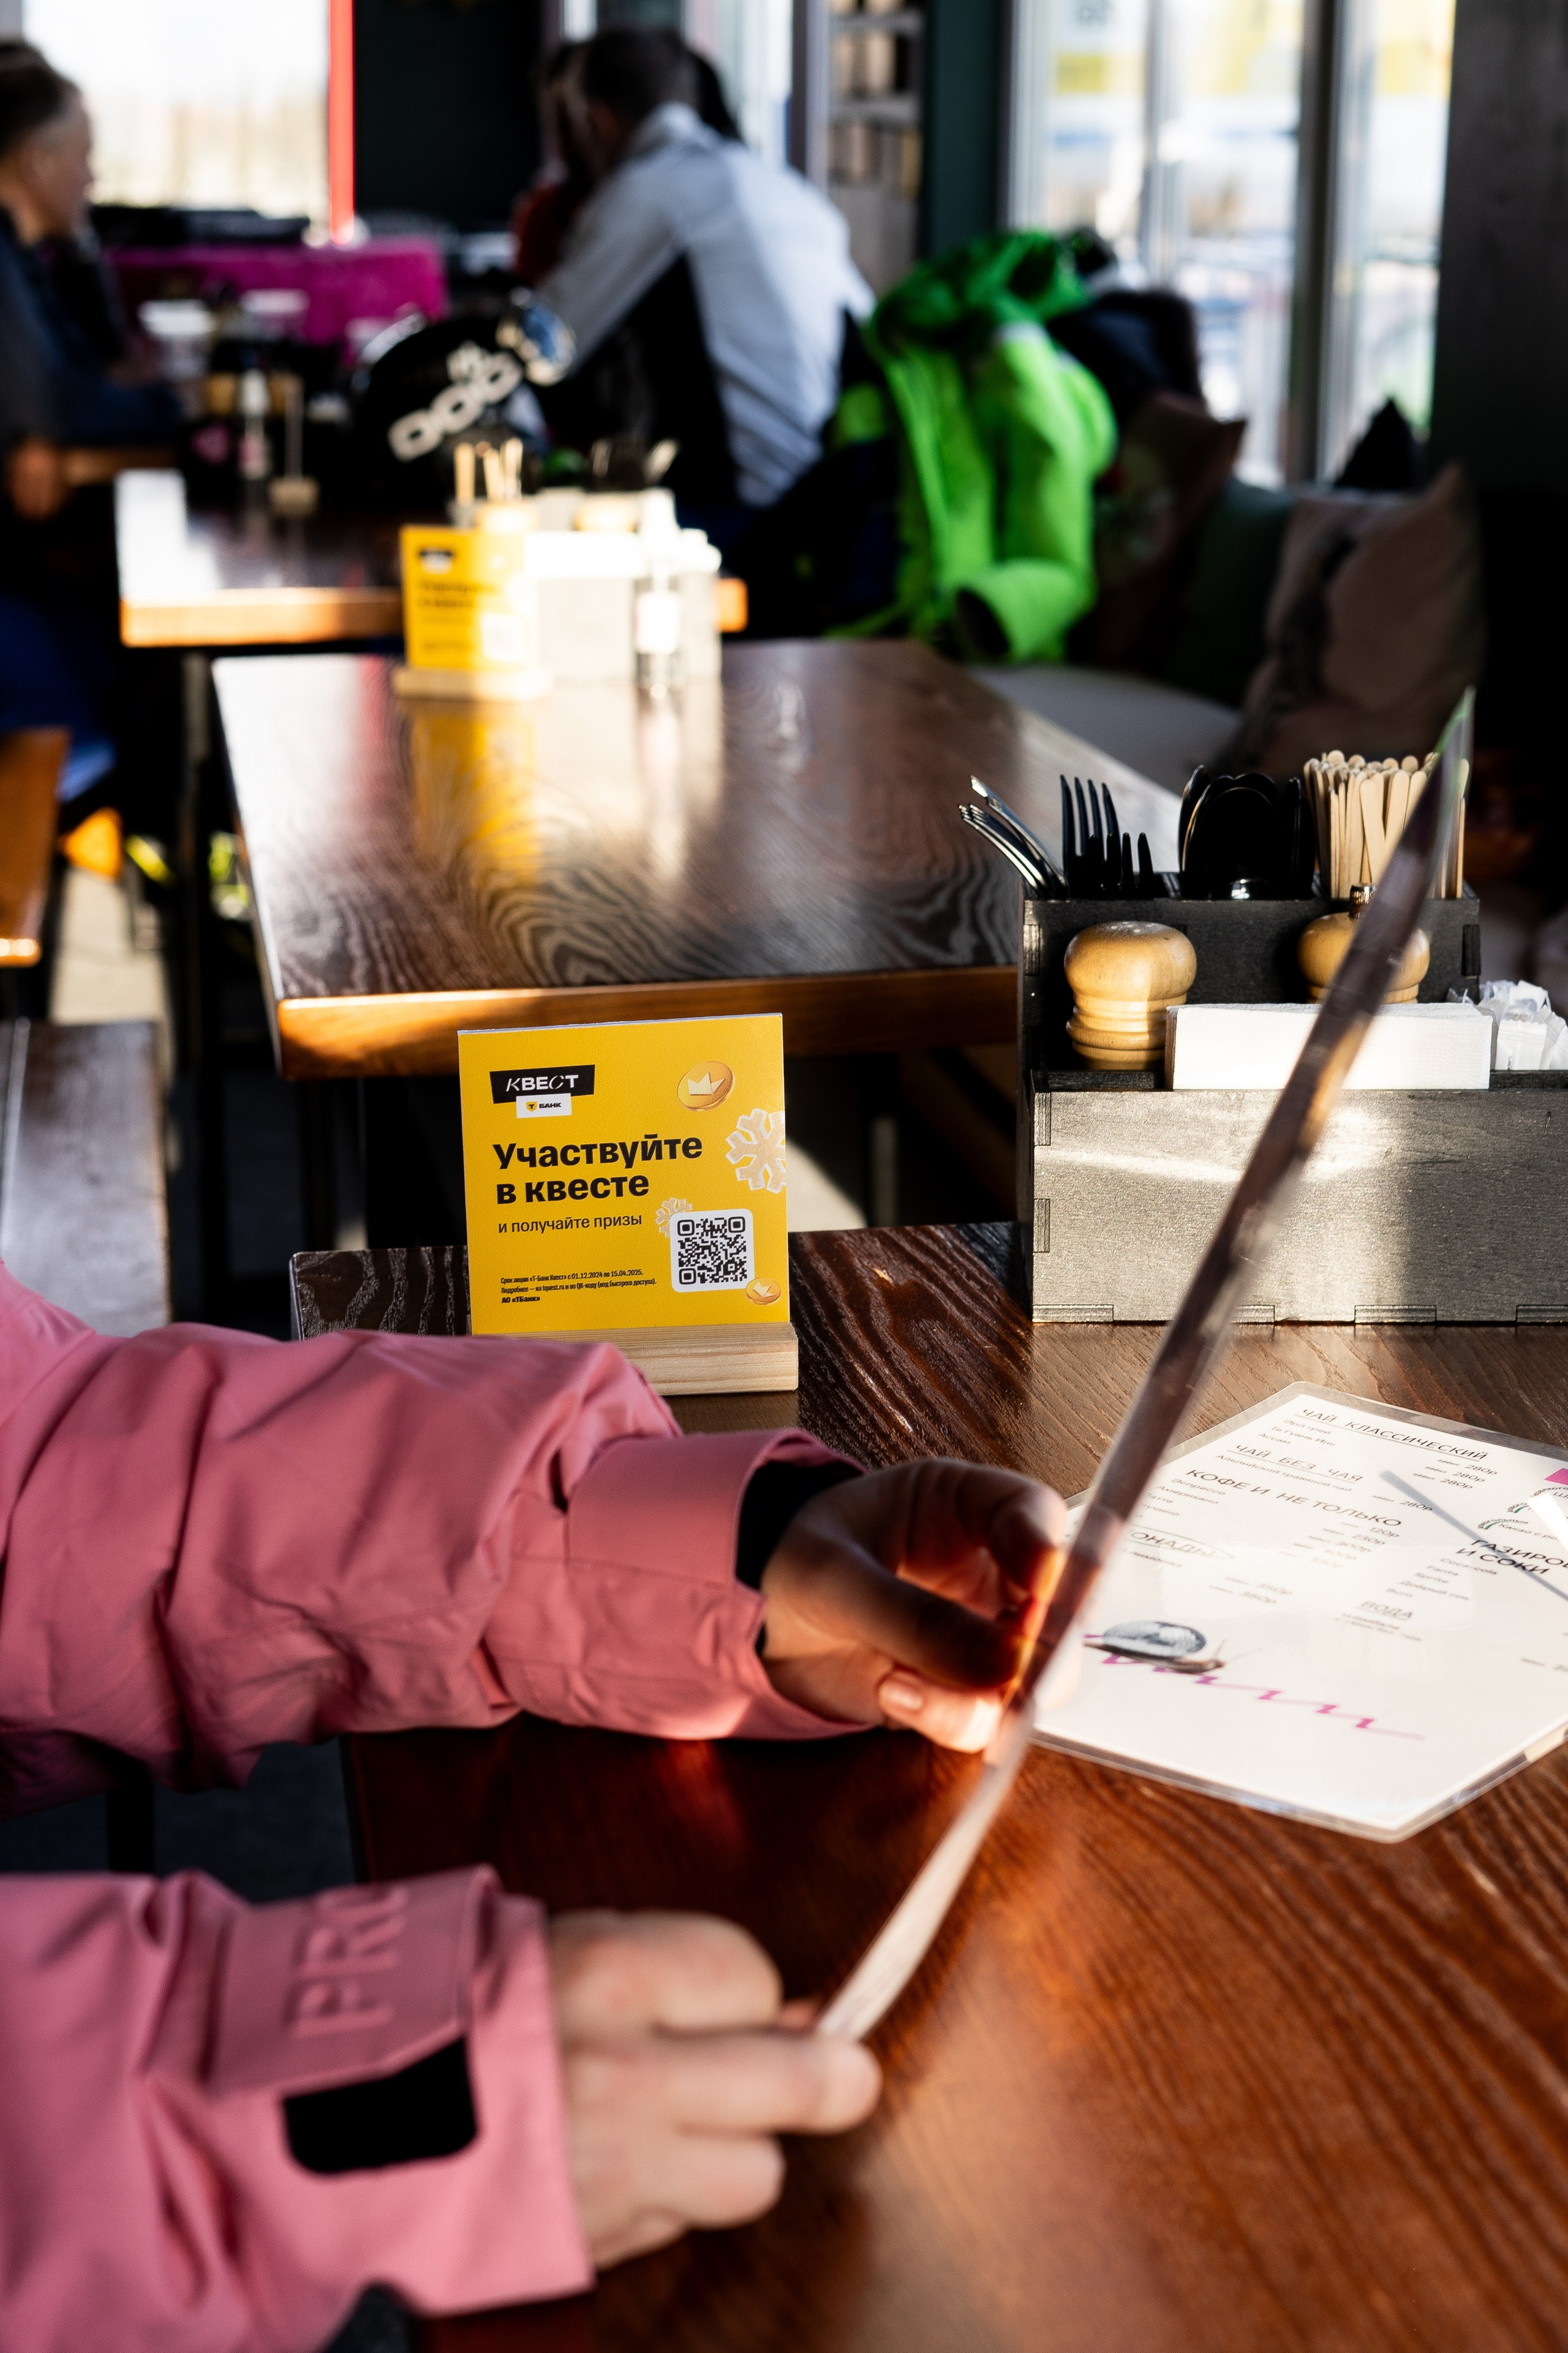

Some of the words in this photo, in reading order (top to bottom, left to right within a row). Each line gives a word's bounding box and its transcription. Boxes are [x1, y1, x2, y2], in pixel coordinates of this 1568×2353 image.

[506, 1075, 579, 1092] КВЕСТ
[492, 1133, 703, 1170] Участвуйте
[497, 1183, 516, 1204] в
[525, 1174, 649, 1204] квесте
[499, 1223, 507, 1233] и
[511, 1216, 590, 1234] получайте
[594, 1214, 643, 1231] призы
[611, 1269, 644, 1277] 15.04.2025.
[501, 1286, 529, 1294] Подробнее
[1257, 1433, 1291, 1445] Ассам
[1303, 1409, 1339, 1422] ЧАЙ
[1345, 1421, 1489, 1459] КЛАССИЧЕСКИЙ
[1236, 1445, 1272, 1458] ЧАЙ
[1279, 1457, 1316, 1470] БЕЗ
[1329, 1468, 1363, 1482] ЧАЯ
[1464, 1464, 1498, 1475] 280р
[1440, 1478, 1473, 1489] 280р
[1452, 1471, 1485, 1482] 280р
[1155, 1485, 1219, 1505] Американо
[1171, 1478, 1226, 1495] Эспрессо
[1186, 1469, 1251, 1490] КОФЕ
[1250, 1486, 1270, 1495] И
[1276, 1492, 1310, 1505] НЕ
[1313, 1500, 1401, 1525] ТОЛЬКО
[1456, 1548, 1477, 1557] И
[1480, 1554, 1550, 1574] СОКИ
[1360, 1601, 1413, 1618] ВОДА
